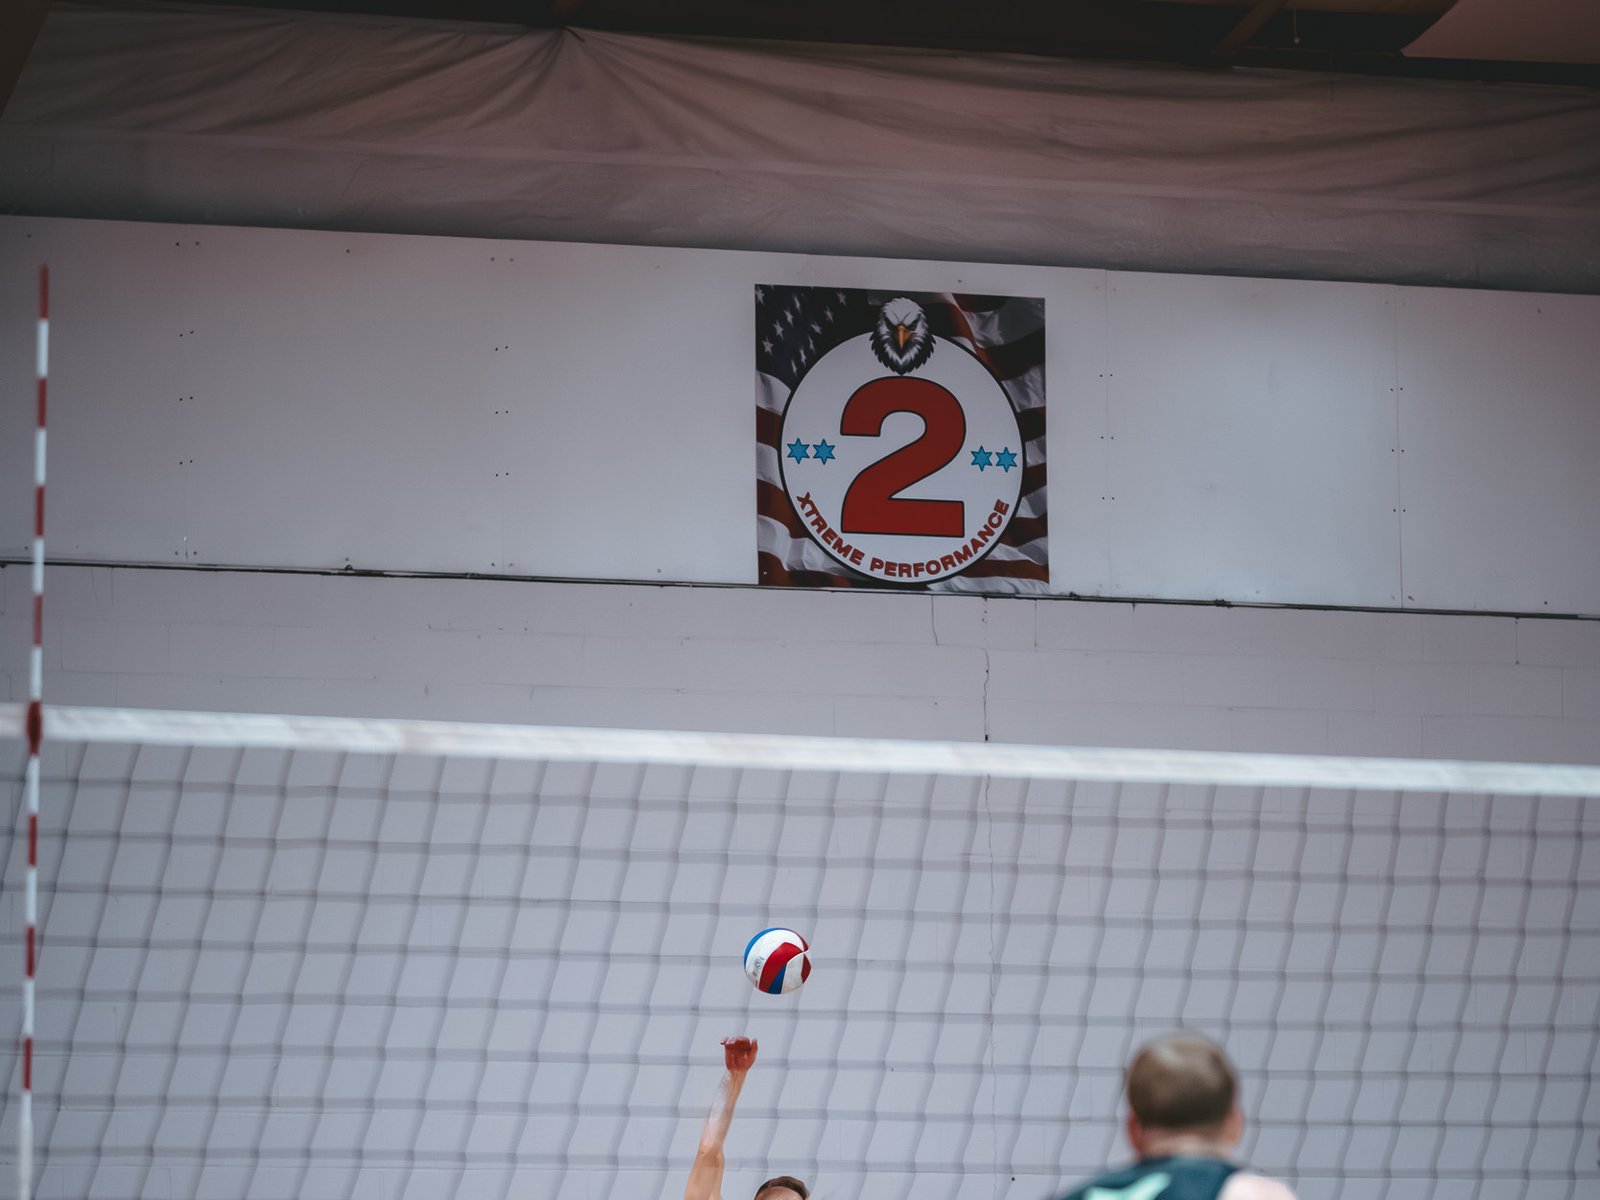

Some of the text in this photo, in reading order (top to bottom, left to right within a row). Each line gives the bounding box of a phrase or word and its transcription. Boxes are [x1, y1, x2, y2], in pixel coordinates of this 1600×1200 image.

[840, 376, 966, 537] 2
[797, 492, 1010, 577] XTREME PERFORMANCE
